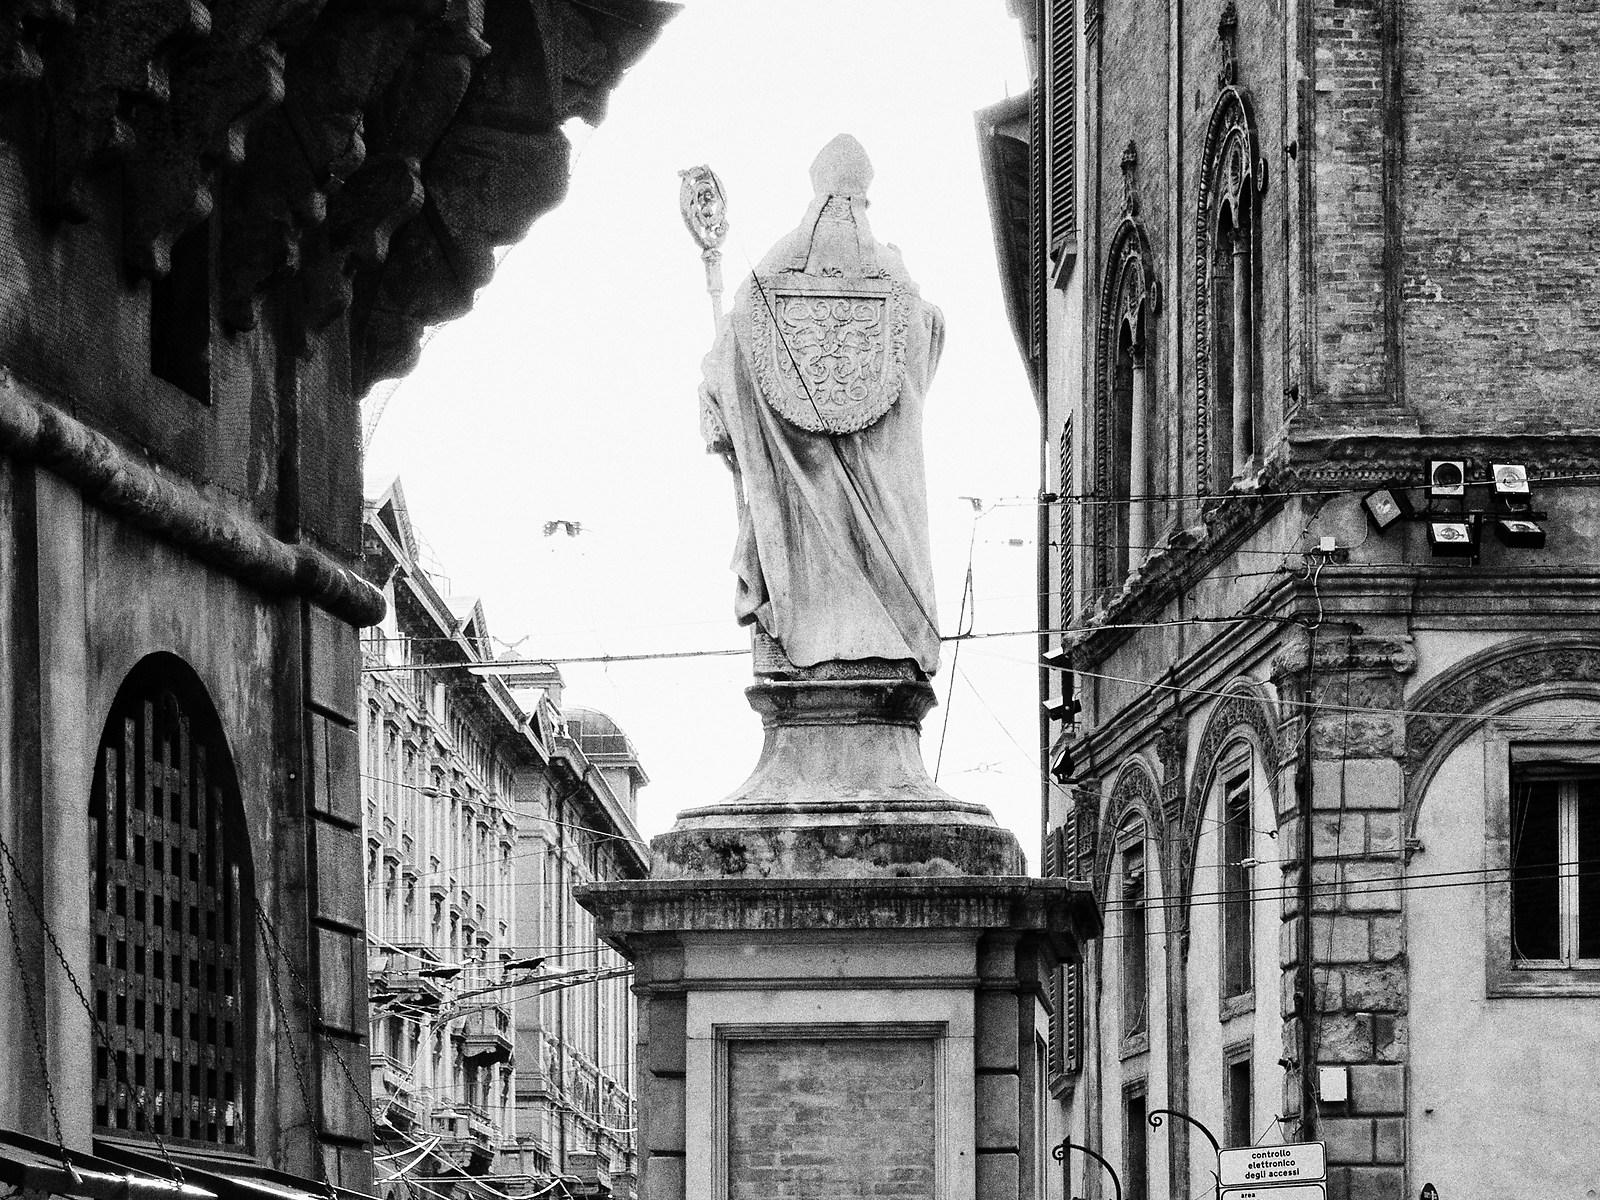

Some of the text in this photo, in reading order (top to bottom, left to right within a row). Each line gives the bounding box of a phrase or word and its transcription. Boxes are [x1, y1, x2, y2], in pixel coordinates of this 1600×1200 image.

[1251, 1149, 1291, 1159] controllo
[1248, 1159, 1296, 1169] elettronico
[1245, 1168, 1300, 1180] degli accessi
